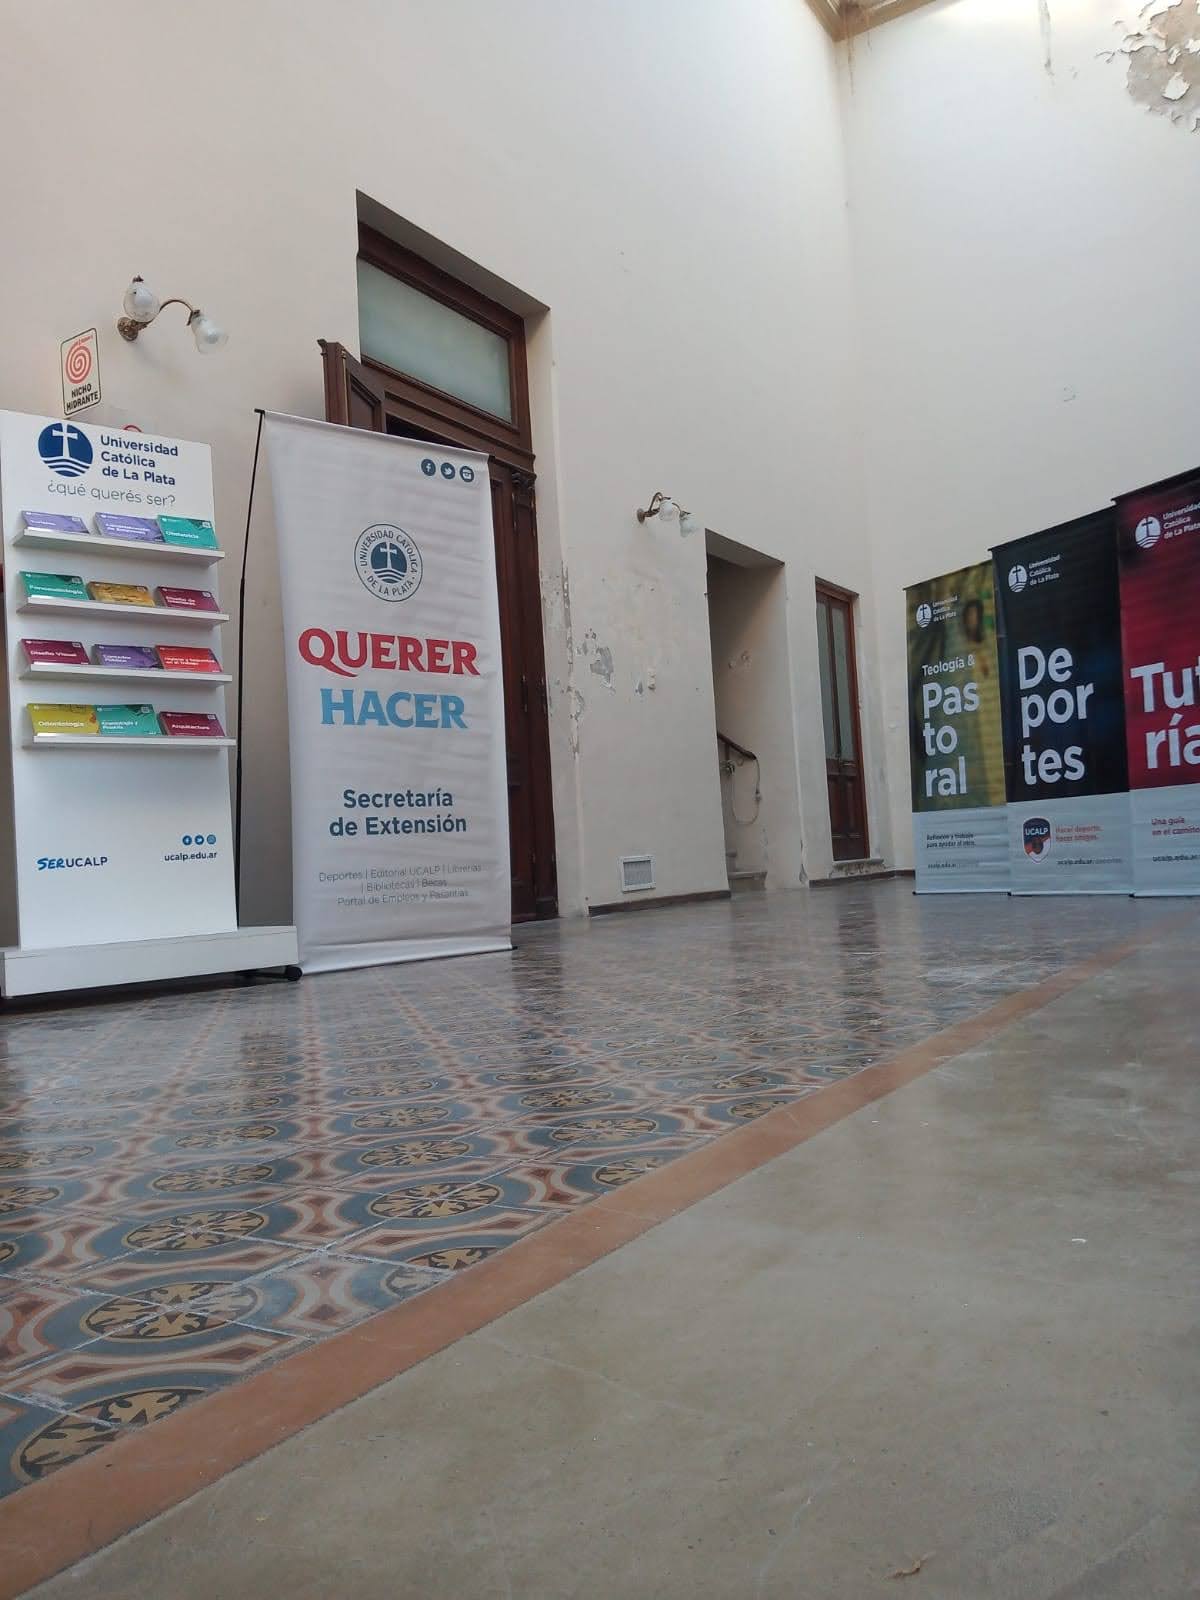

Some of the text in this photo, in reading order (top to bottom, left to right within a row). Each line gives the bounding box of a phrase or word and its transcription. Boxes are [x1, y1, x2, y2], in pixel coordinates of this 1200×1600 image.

[66, 391, 98, 412] HIDRANTE
[72, 384, 92, 398] NICHO
[101, 434, 178, 457] Universidad
[101, 452, 156, 468] Católica
[102, 467, 175, 486] de La Plata
[48, 480, 175, 506] ¿qué querés ser?
[1163, 531, 1173, 539] de
[359, 530, 418, 573] UNIVERSIDAD CATOLICA
[367, 575, 414, 596] DE LA PLATA
[298, 627, 481, 677] QUERER
[922, 654, 975, 677] Teología &
[1017, 645, 1073, 690] De
[1130, 656, 1200, 713] Tu
[320, 688, 468, 729] HACER
[922, 681, 980, 719] Pas
[1020, 683, 1094, 738] por
[922, 722, 958, 756] to
[1021, 744, 1085, 785] tes
[925, 756, 967, 798] ral
[343, 788, 453, 808] Secretaría
[329, 814, 467, 836] de Extensión
[1025, 827, 1048, 836] UCALP
[36, 856, 108, 871] SERUCALP
[164, 851, 217, 863] ucalp.edu.ar
[319, 871, 363, 883] Deportes
[371, 868, 406, 879] Editorial
[409, 865, 440, 876] UCALP
[421, 878, 447, 887] Becas
[337, 897, 365, 907] Portal
[368, 896, 379, 905] de
